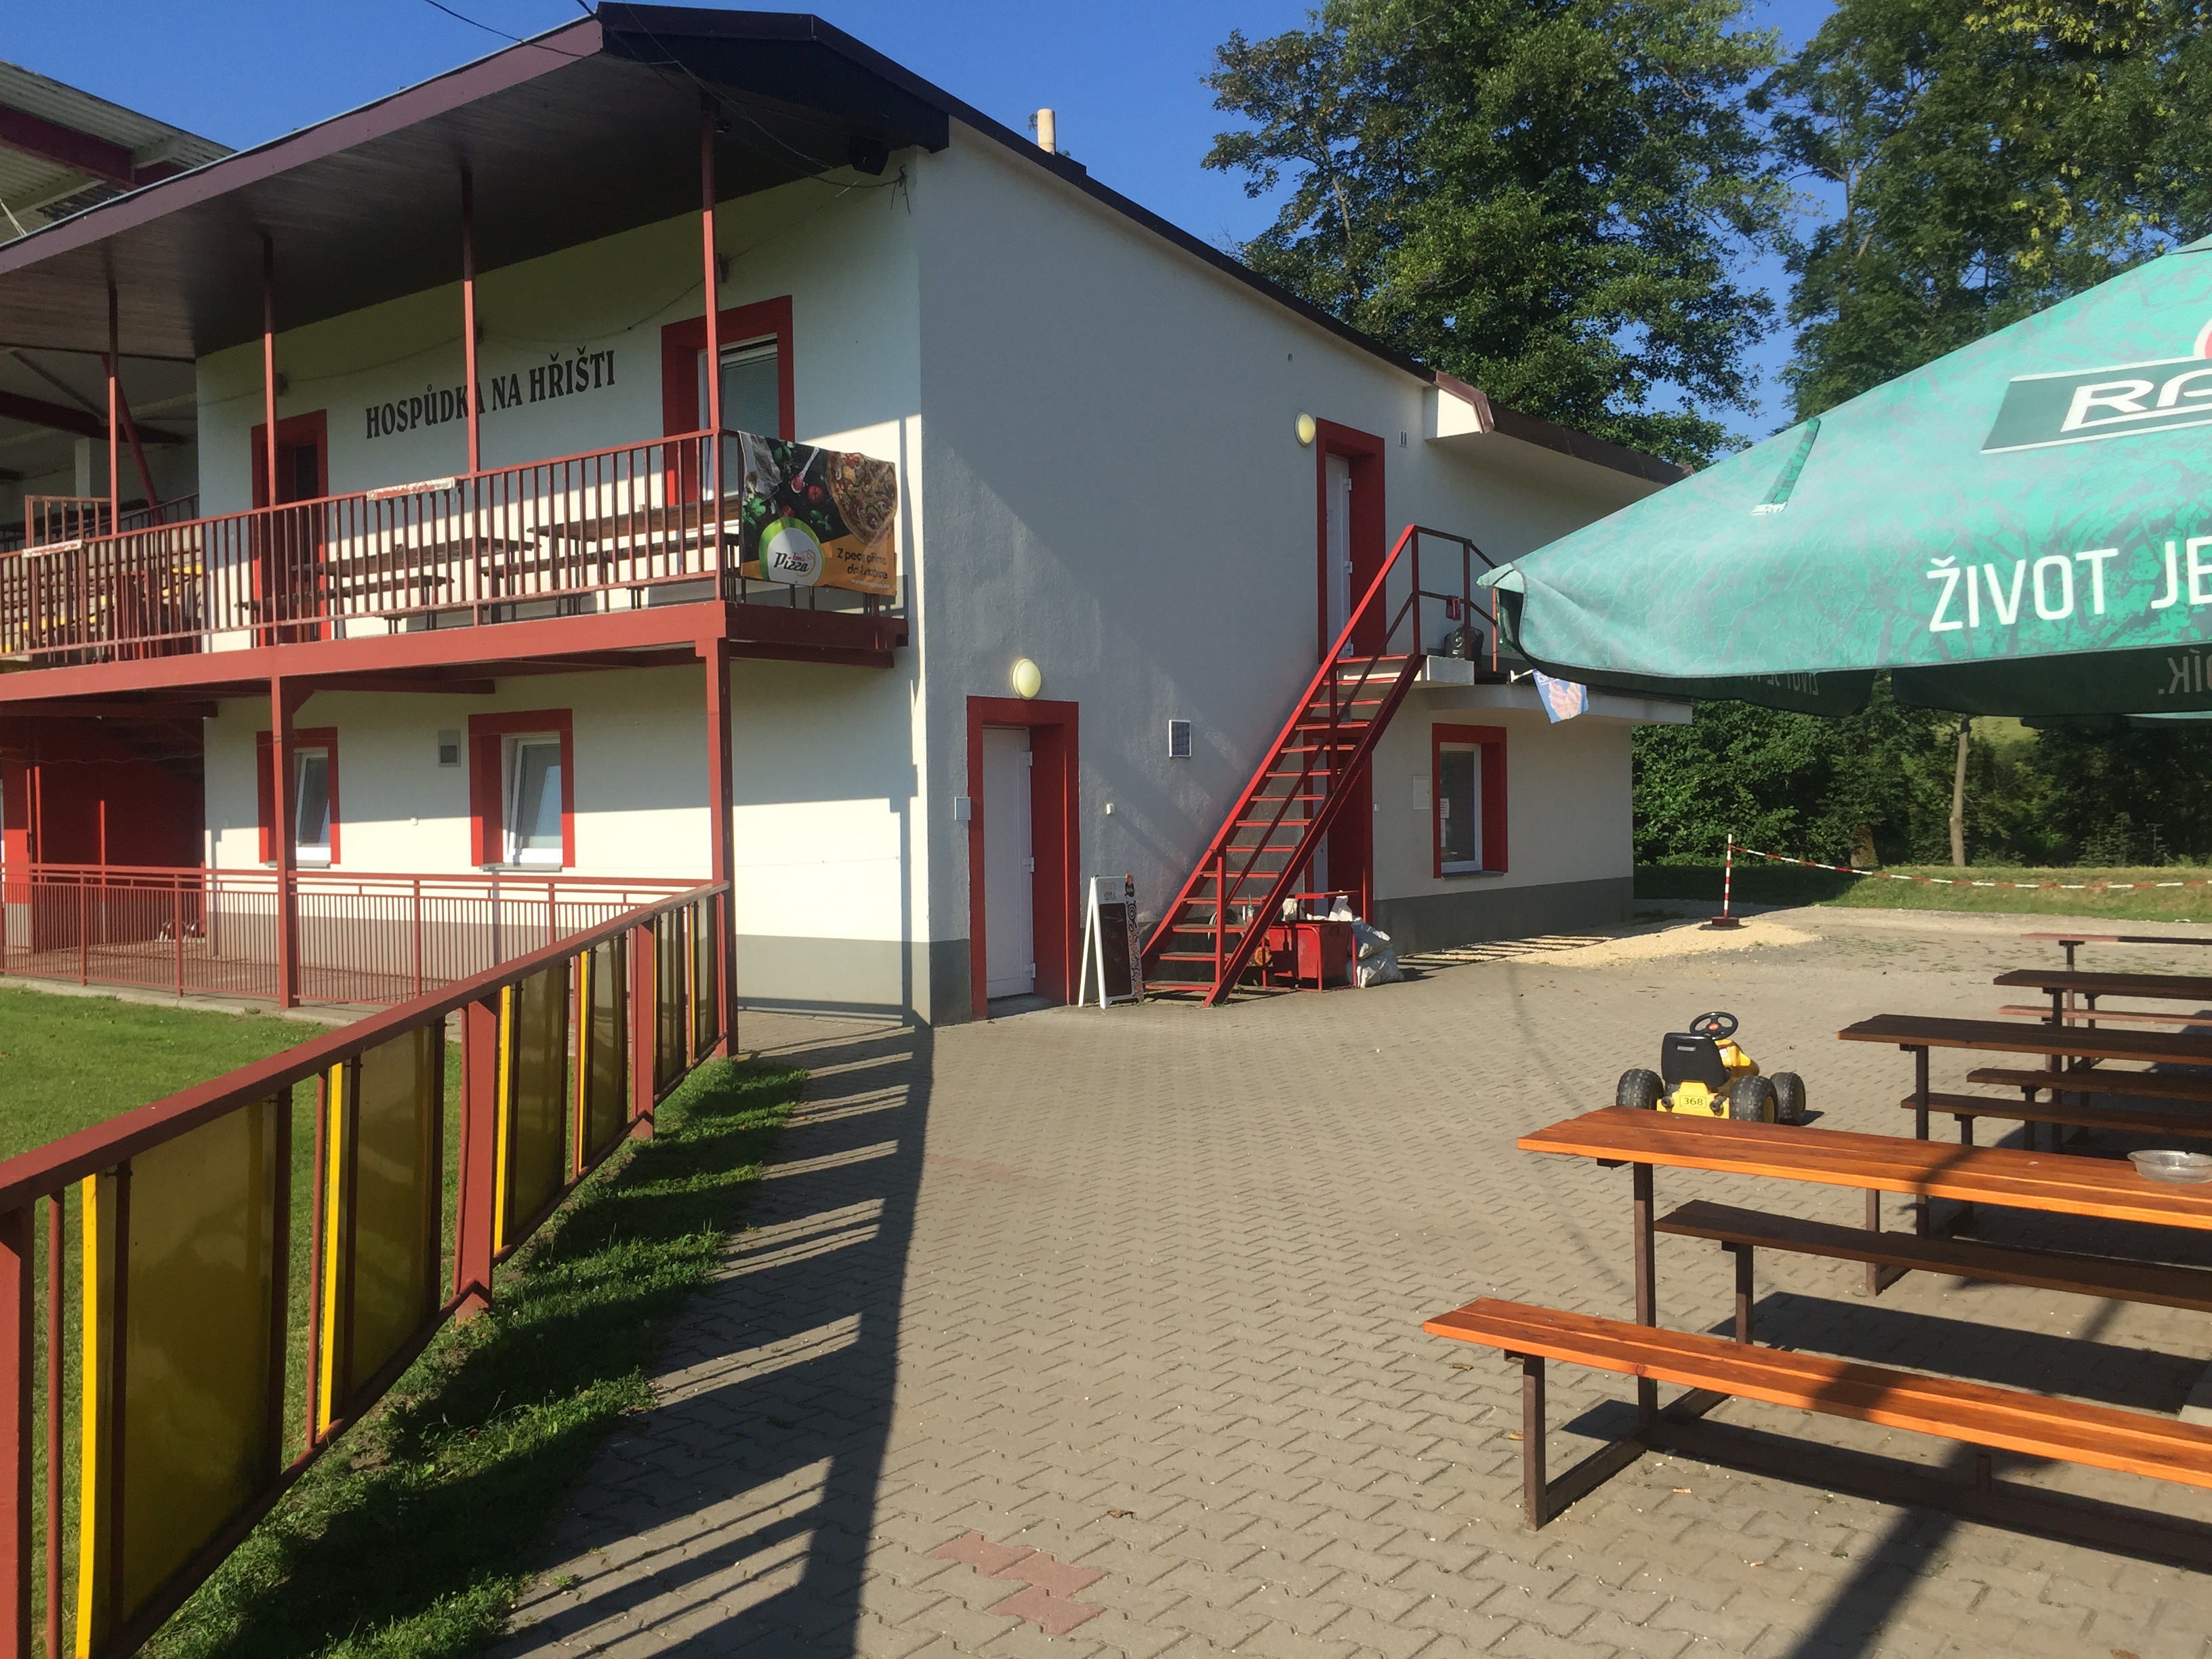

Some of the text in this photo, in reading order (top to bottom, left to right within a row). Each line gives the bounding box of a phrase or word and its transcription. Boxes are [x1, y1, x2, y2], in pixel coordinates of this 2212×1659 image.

[491, 373, 523, 411] NA
[529, 345, 615, 403] HŘIŠTI
[773, 552, 810, 572] Pizza
[837, 548, 844, 559] Z
[1926, 535, 2212, 632] ŽIVOT JE
[1683, 1097, 1704, 1106] 368
